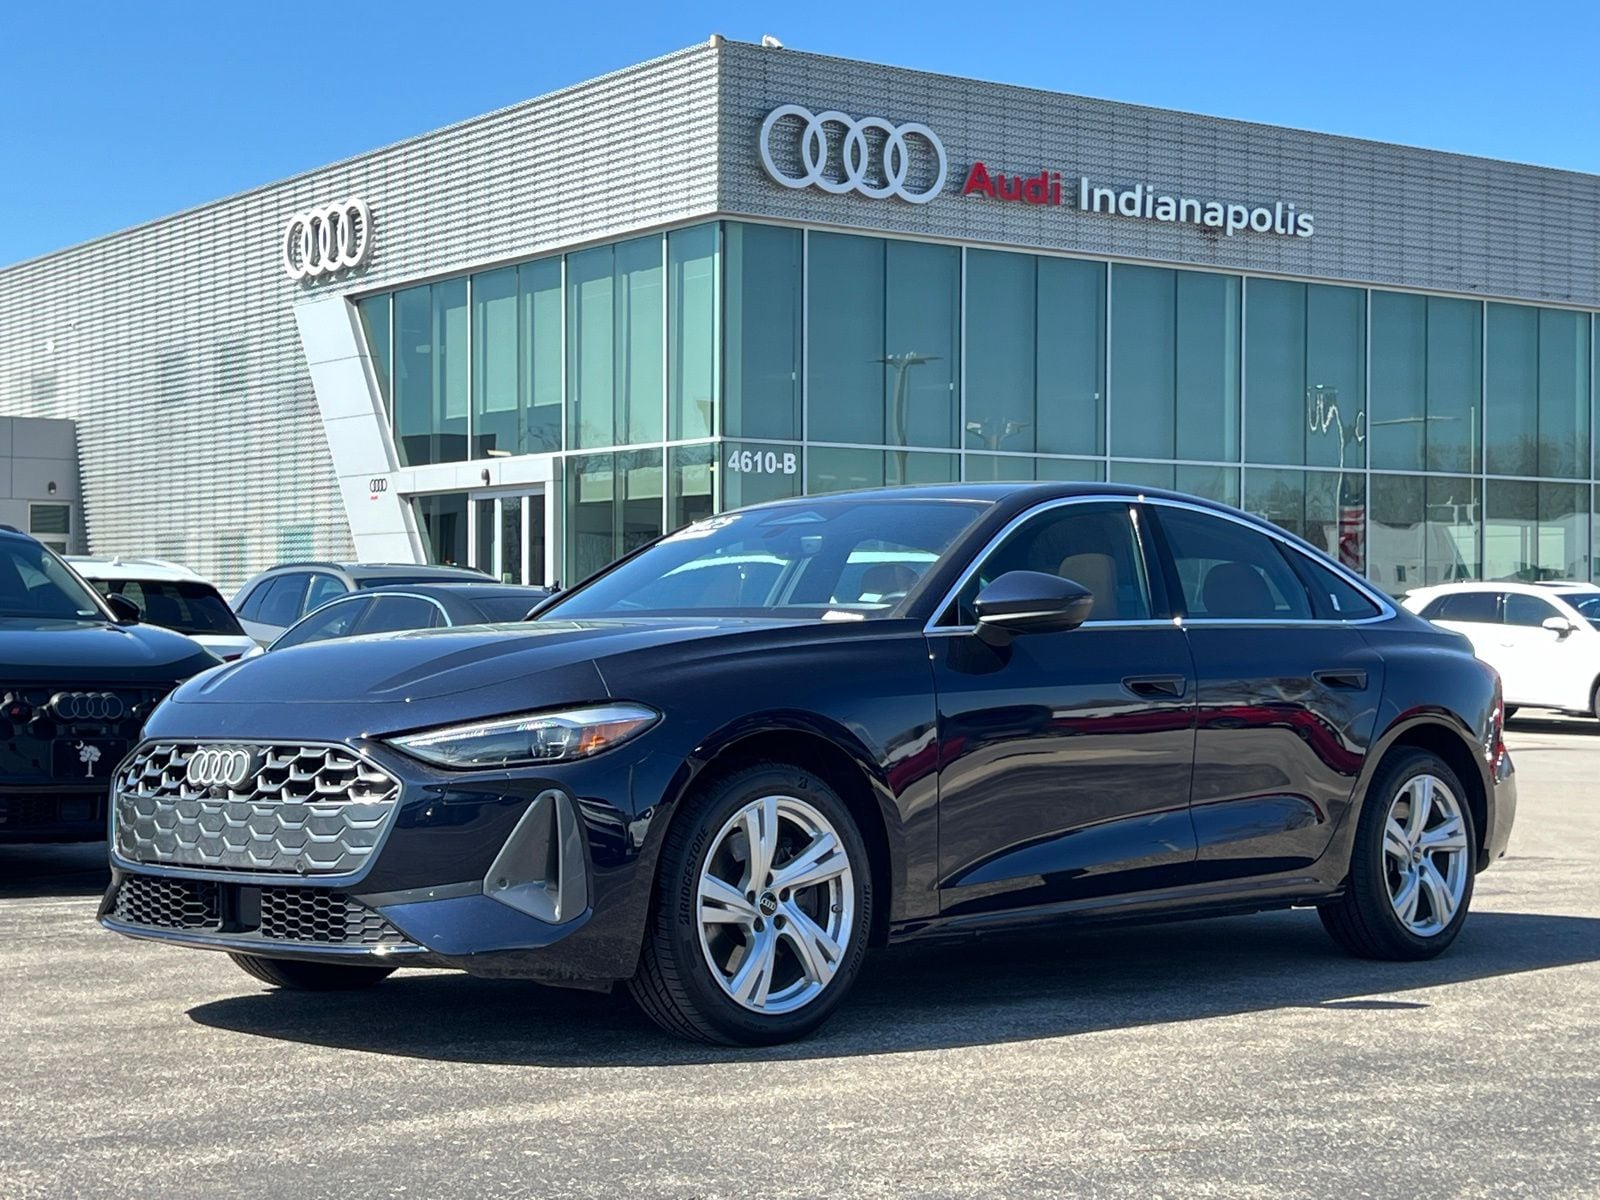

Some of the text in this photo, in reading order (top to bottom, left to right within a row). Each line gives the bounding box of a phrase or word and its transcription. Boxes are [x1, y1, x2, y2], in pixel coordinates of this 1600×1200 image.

[961, 161, 1315, 237] Audi Indianapolis
[727, 450, 797, 474] 4610-B
[680, 825, 709, 926] BRIDGESTONE
